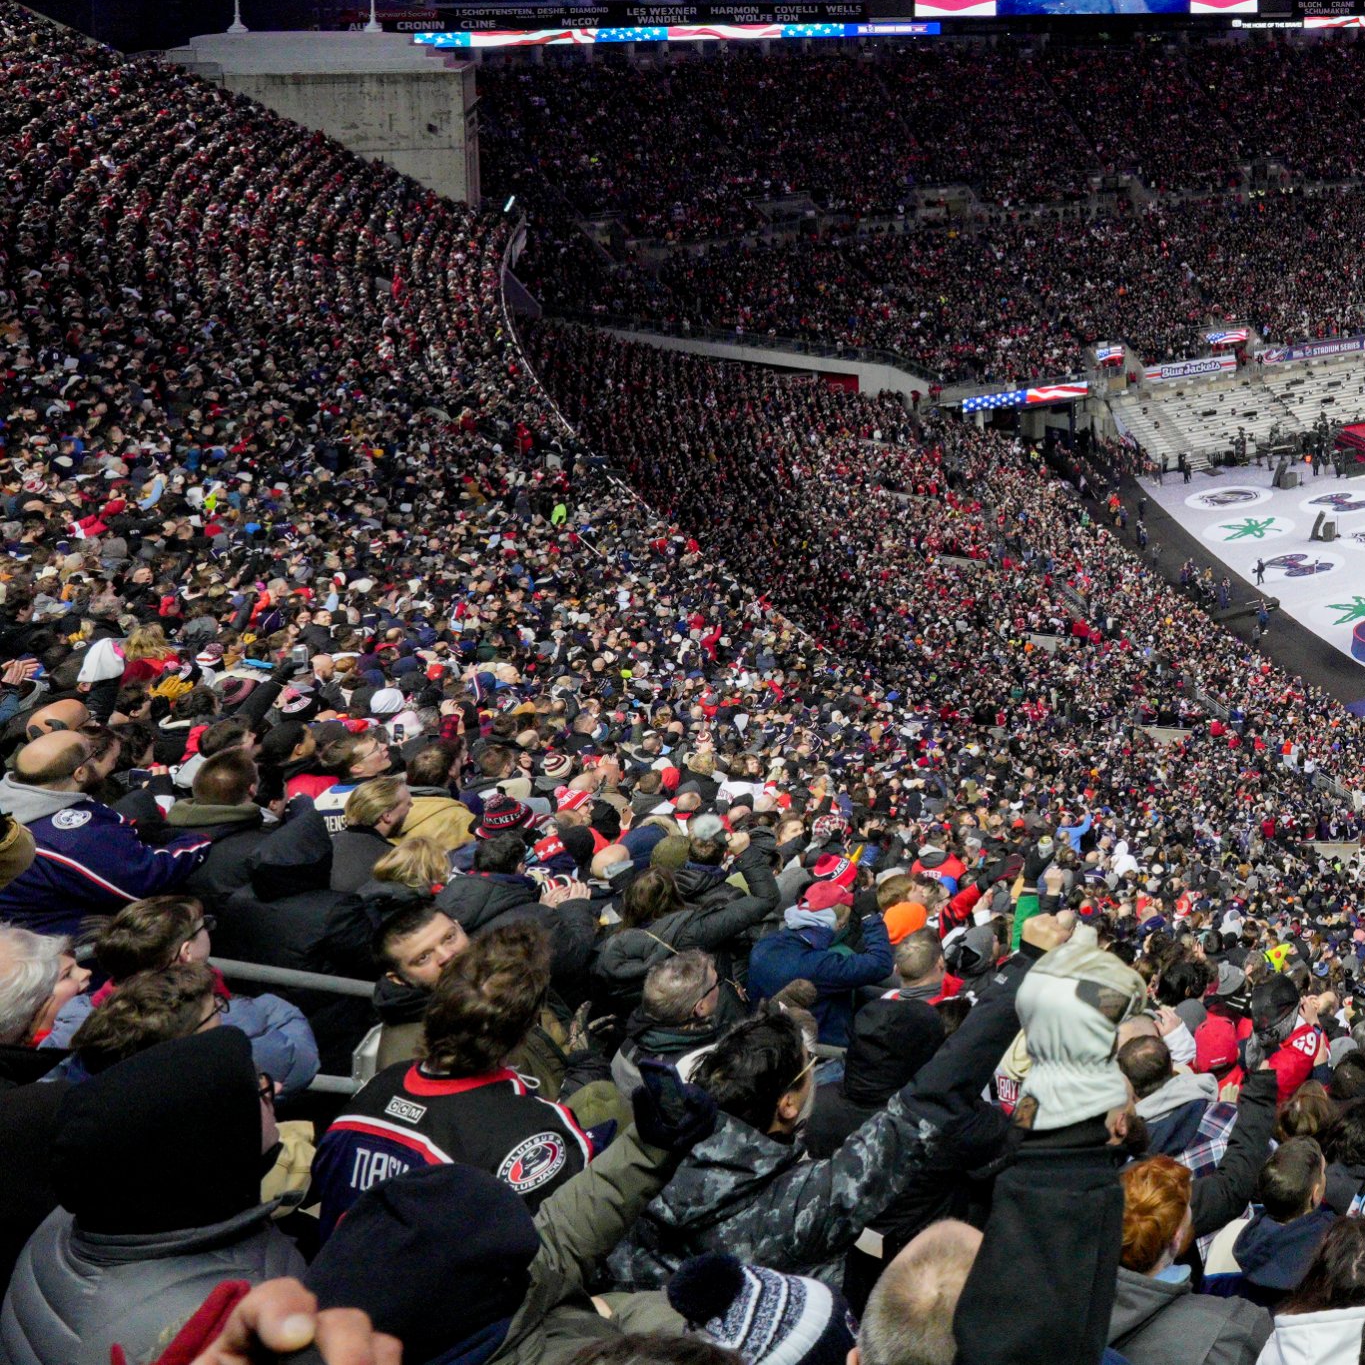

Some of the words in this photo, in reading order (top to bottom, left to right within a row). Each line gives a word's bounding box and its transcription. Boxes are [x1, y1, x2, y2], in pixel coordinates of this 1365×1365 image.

[570, 6, 609, 14] DIAMOND
[626, 7, 646, 17] LES
[649, 6, 697, 16] WEXNER
[710, 5, 760, 15] HARMON
[774, 5, 819, 14] COVELLI
[825, 4, 862, 14] WELLS
[1304, 7, 1350, 16] SCHUMAKER
[561, 17, 599, 27] McCOY
[637, 15, 690, 25] WANDELL
[734, 14, 773, 23] WOLFE
[396, 20, 445, 31] CRONIN
[460, 19, 496, 30] CLINE
[1313, 344, 1339, 356] STADIUM
[1339, 341, 1360, 353] SERIES
[1161, 364, 1185, 379] Blue
[1183, 360, 1221, 376] Jackets
[387, 1100, 423, 1122] CCM
[503, 1133, 556, 1177] COLUMBUS
